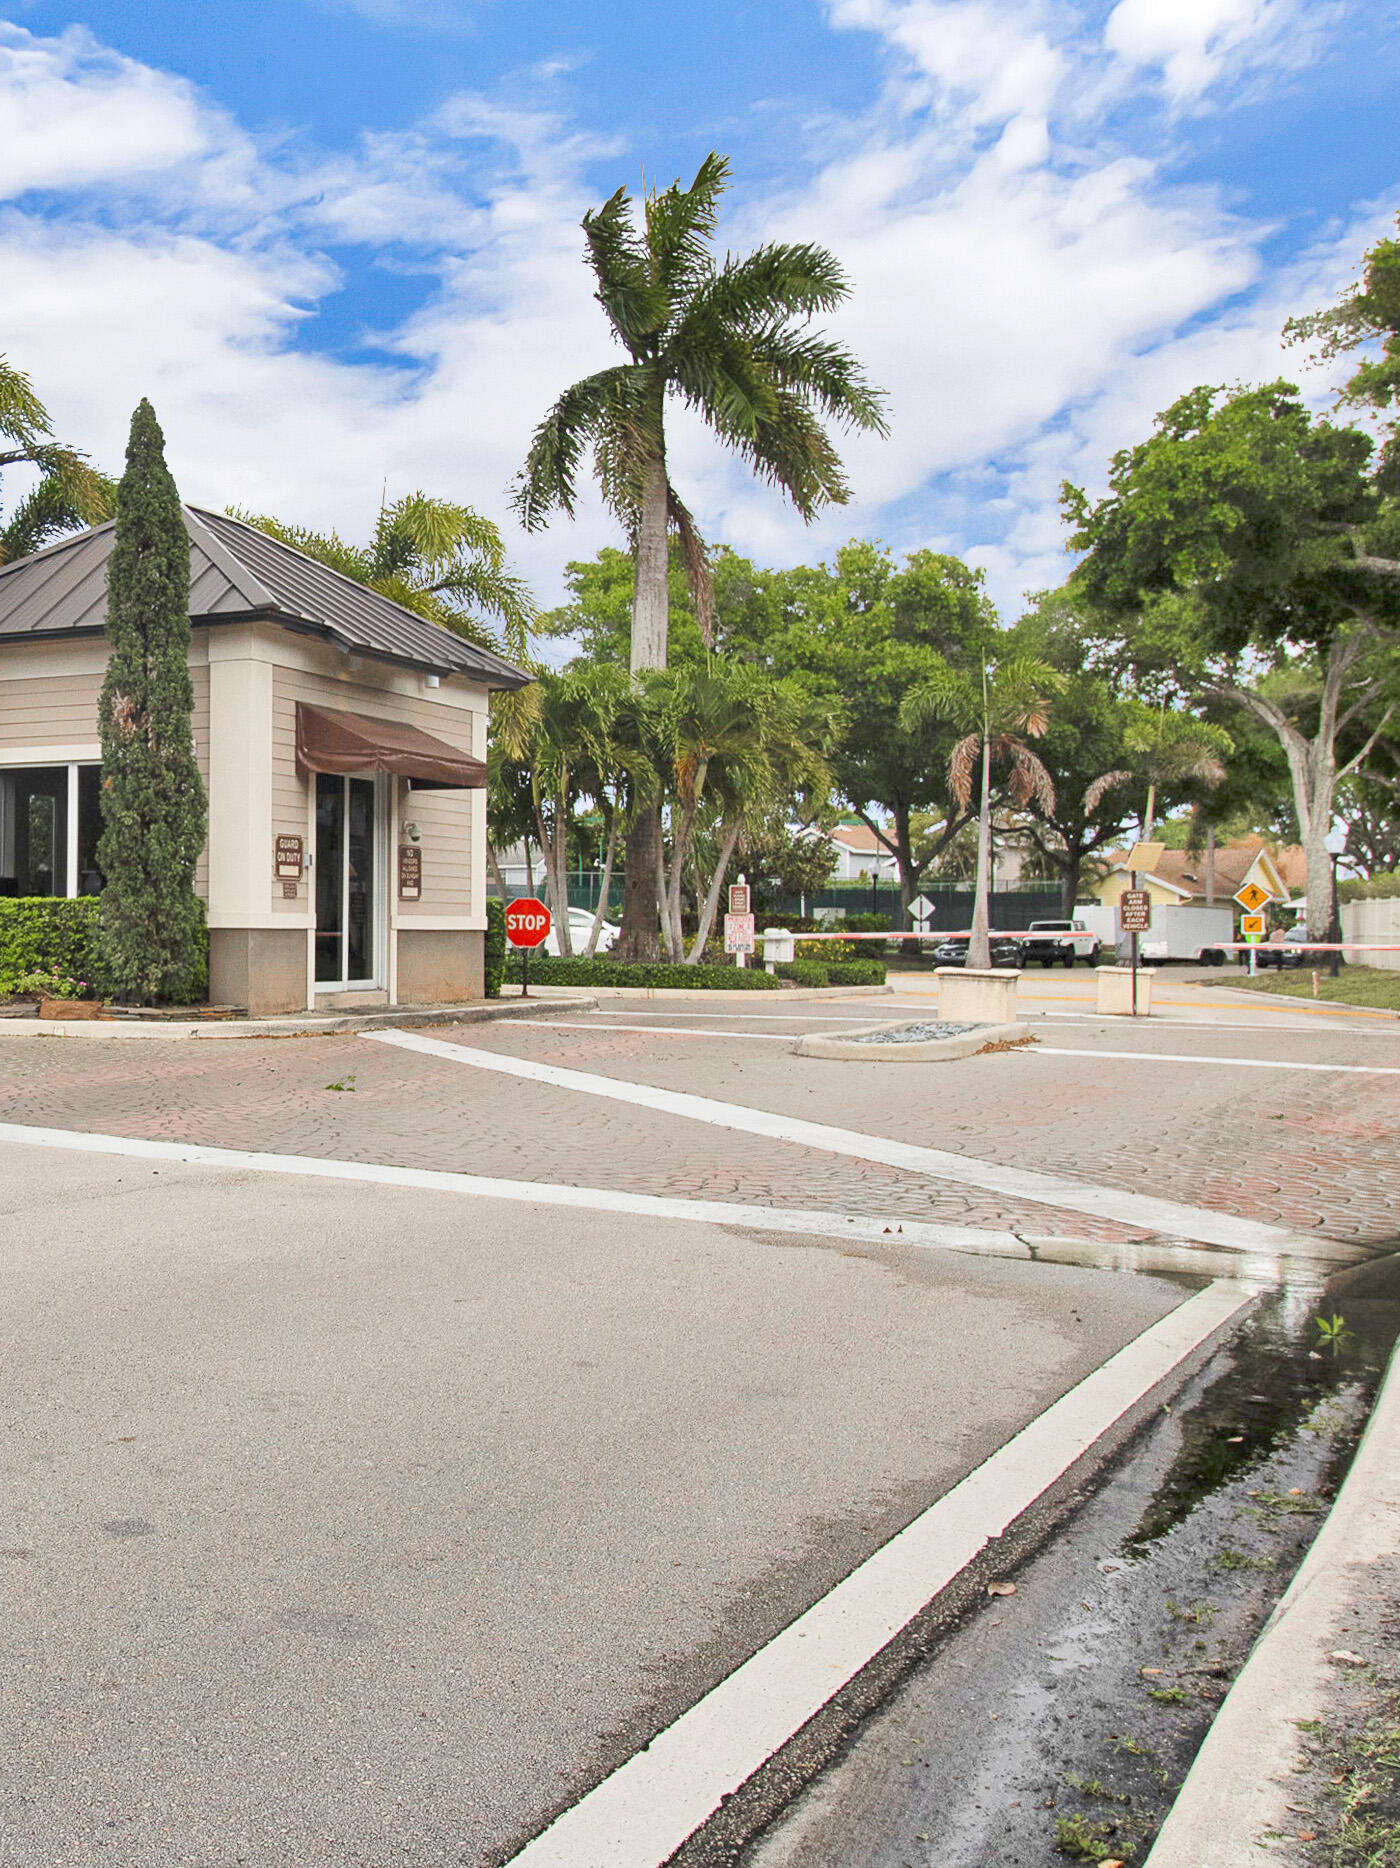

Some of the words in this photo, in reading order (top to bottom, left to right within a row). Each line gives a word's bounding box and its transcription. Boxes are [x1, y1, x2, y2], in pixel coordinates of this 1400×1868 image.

[279, 838, 299, 850] GUARD
[277, 852, 285, 862] ON
[287, 852, 301, 863] DUTY
[508, 914, 546, 931] STOP
